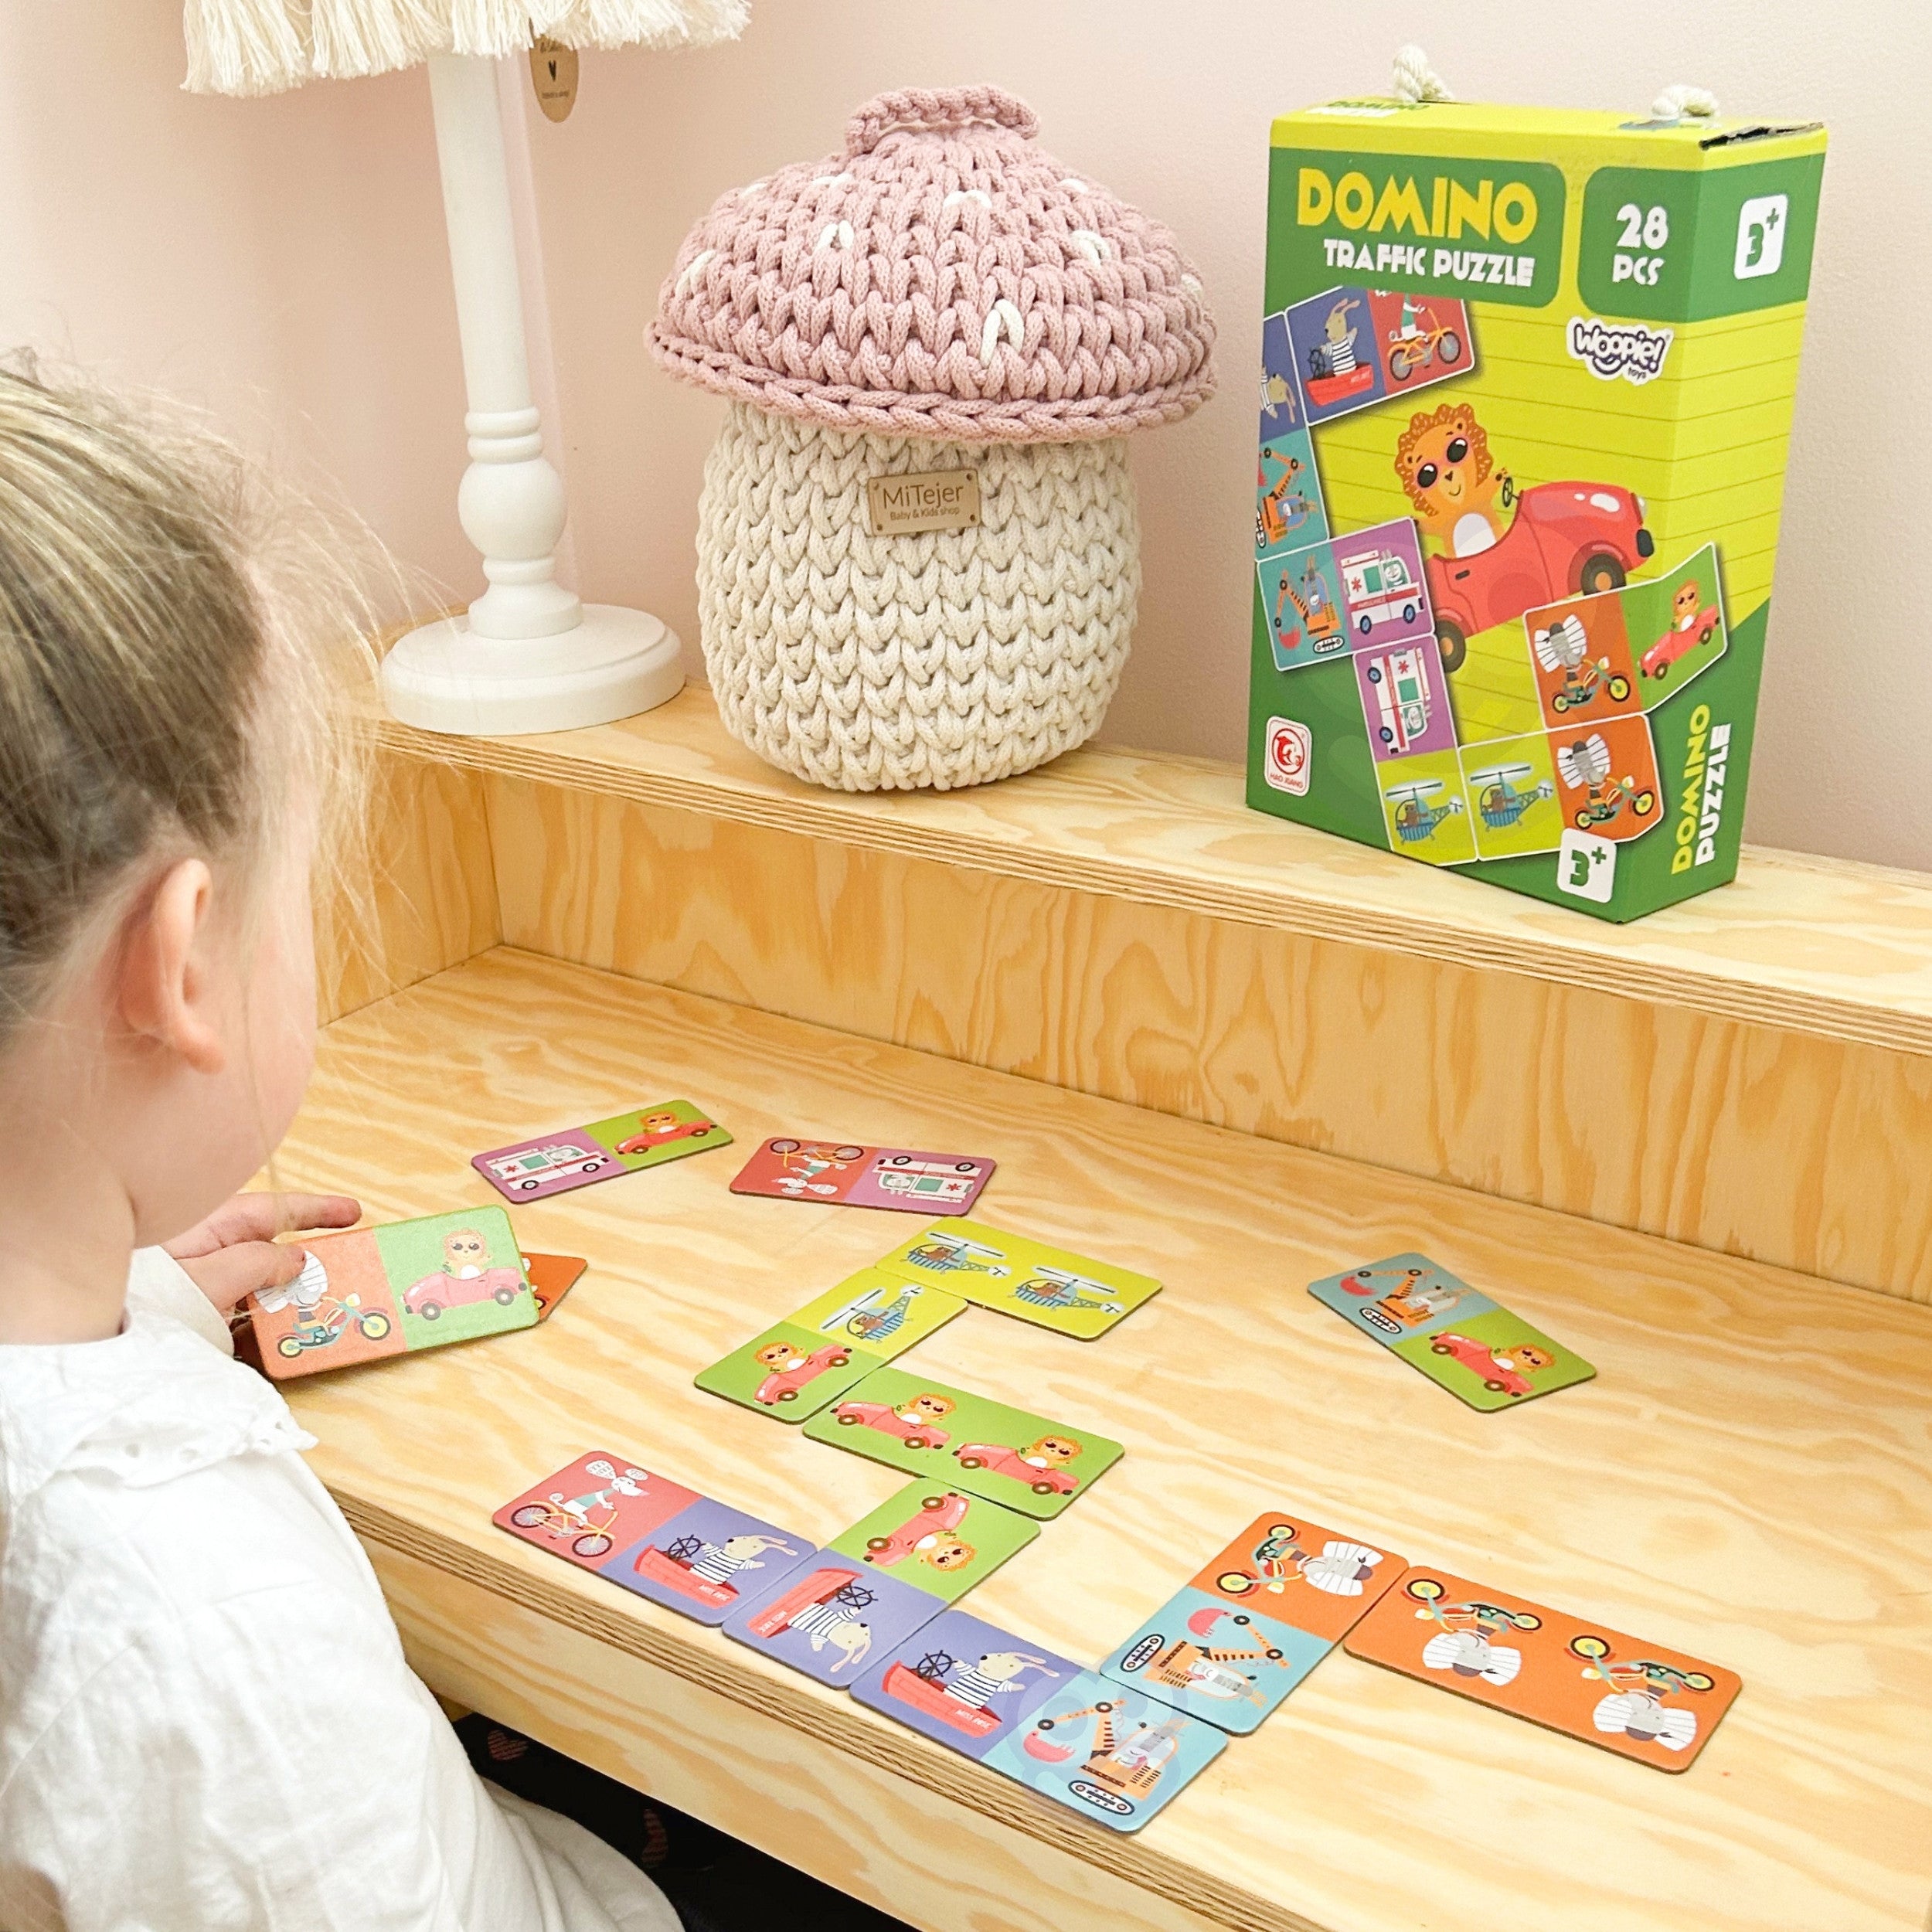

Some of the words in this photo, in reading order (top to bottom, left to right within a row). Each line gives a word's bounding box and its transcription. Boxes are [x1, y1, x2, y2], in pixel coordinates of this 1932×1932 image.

[1297, 167, 1538, 245] DOMINO
[1616, 203, 1668, 250] 28
[1324, 238, 1427, 276] TRAFFIC
[1433, 248, 1536, 287] PUZZLE
[1612, 253, 1665, 286] PCS
[883, 482, 964, 509] MiTejer
[1671, 704, 1711, 875] DOMINO
[1694, 723, 1732, 866] PUZZLE
